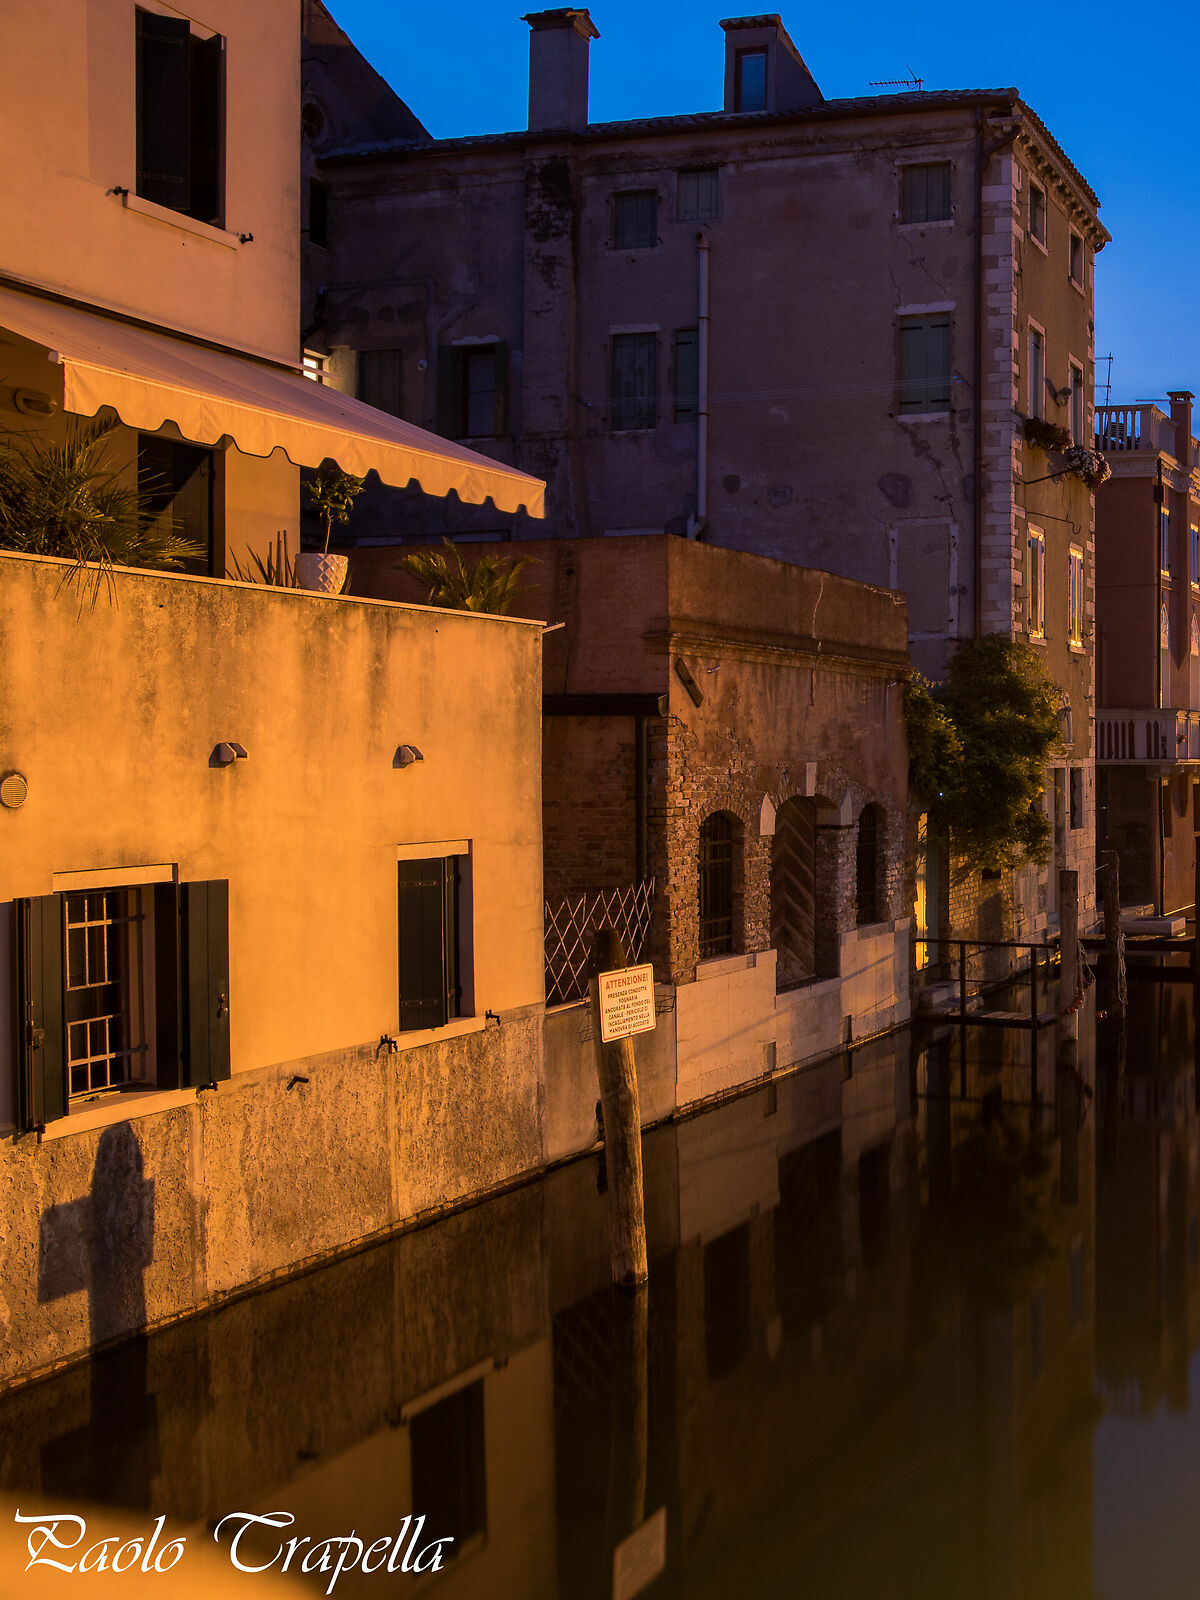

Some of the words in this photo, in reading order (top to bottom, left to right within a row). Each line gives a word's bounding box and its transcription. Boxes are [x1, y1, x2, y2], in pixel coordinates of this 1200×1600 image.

[605, 973, 648, 990] ATTENZIONE!
[607, 990, 628, 999] PRESENZA
[608, 1012, 624, 1020] CANALE
